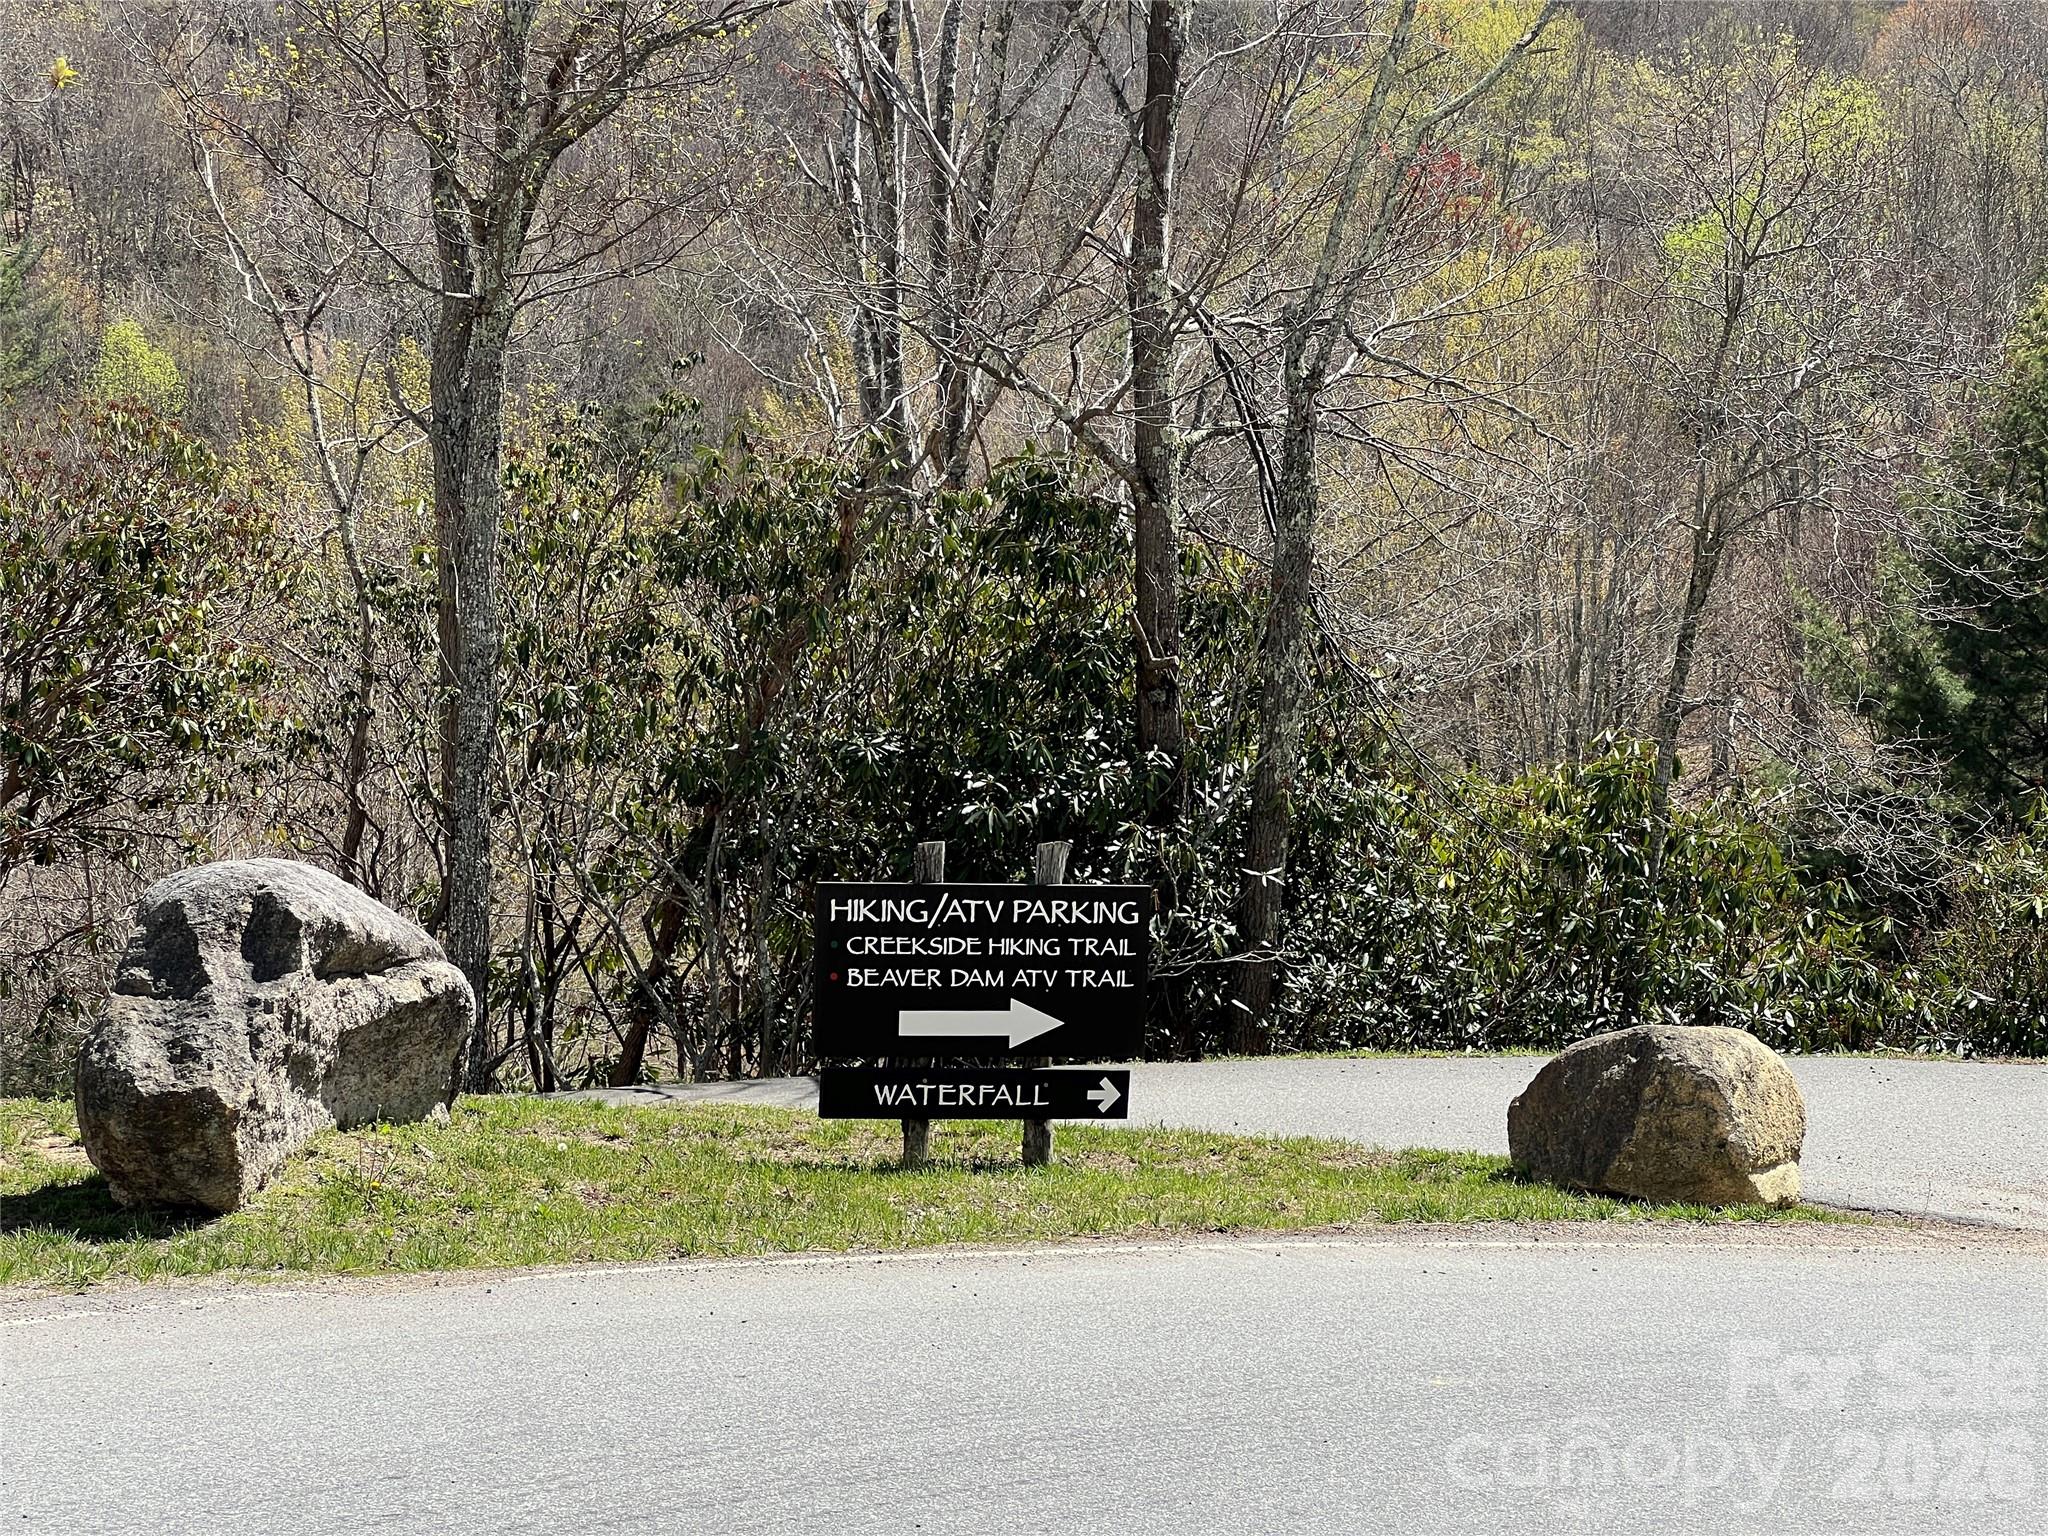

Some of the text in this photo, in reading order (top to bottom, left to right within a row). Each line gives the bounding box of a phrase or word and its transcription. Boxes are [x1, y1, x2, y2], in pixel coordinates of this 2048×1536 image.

[830, 892, 1139, 929] HIKING/ATV PARKING
[846, 936, 1137, 957] CREEKSIDE HIKING TRAIL
[846, 968, 1135, 988] BEAVER DAM ATV TRAIL
[874, 1083, 1050, 1107] WATERFALL
